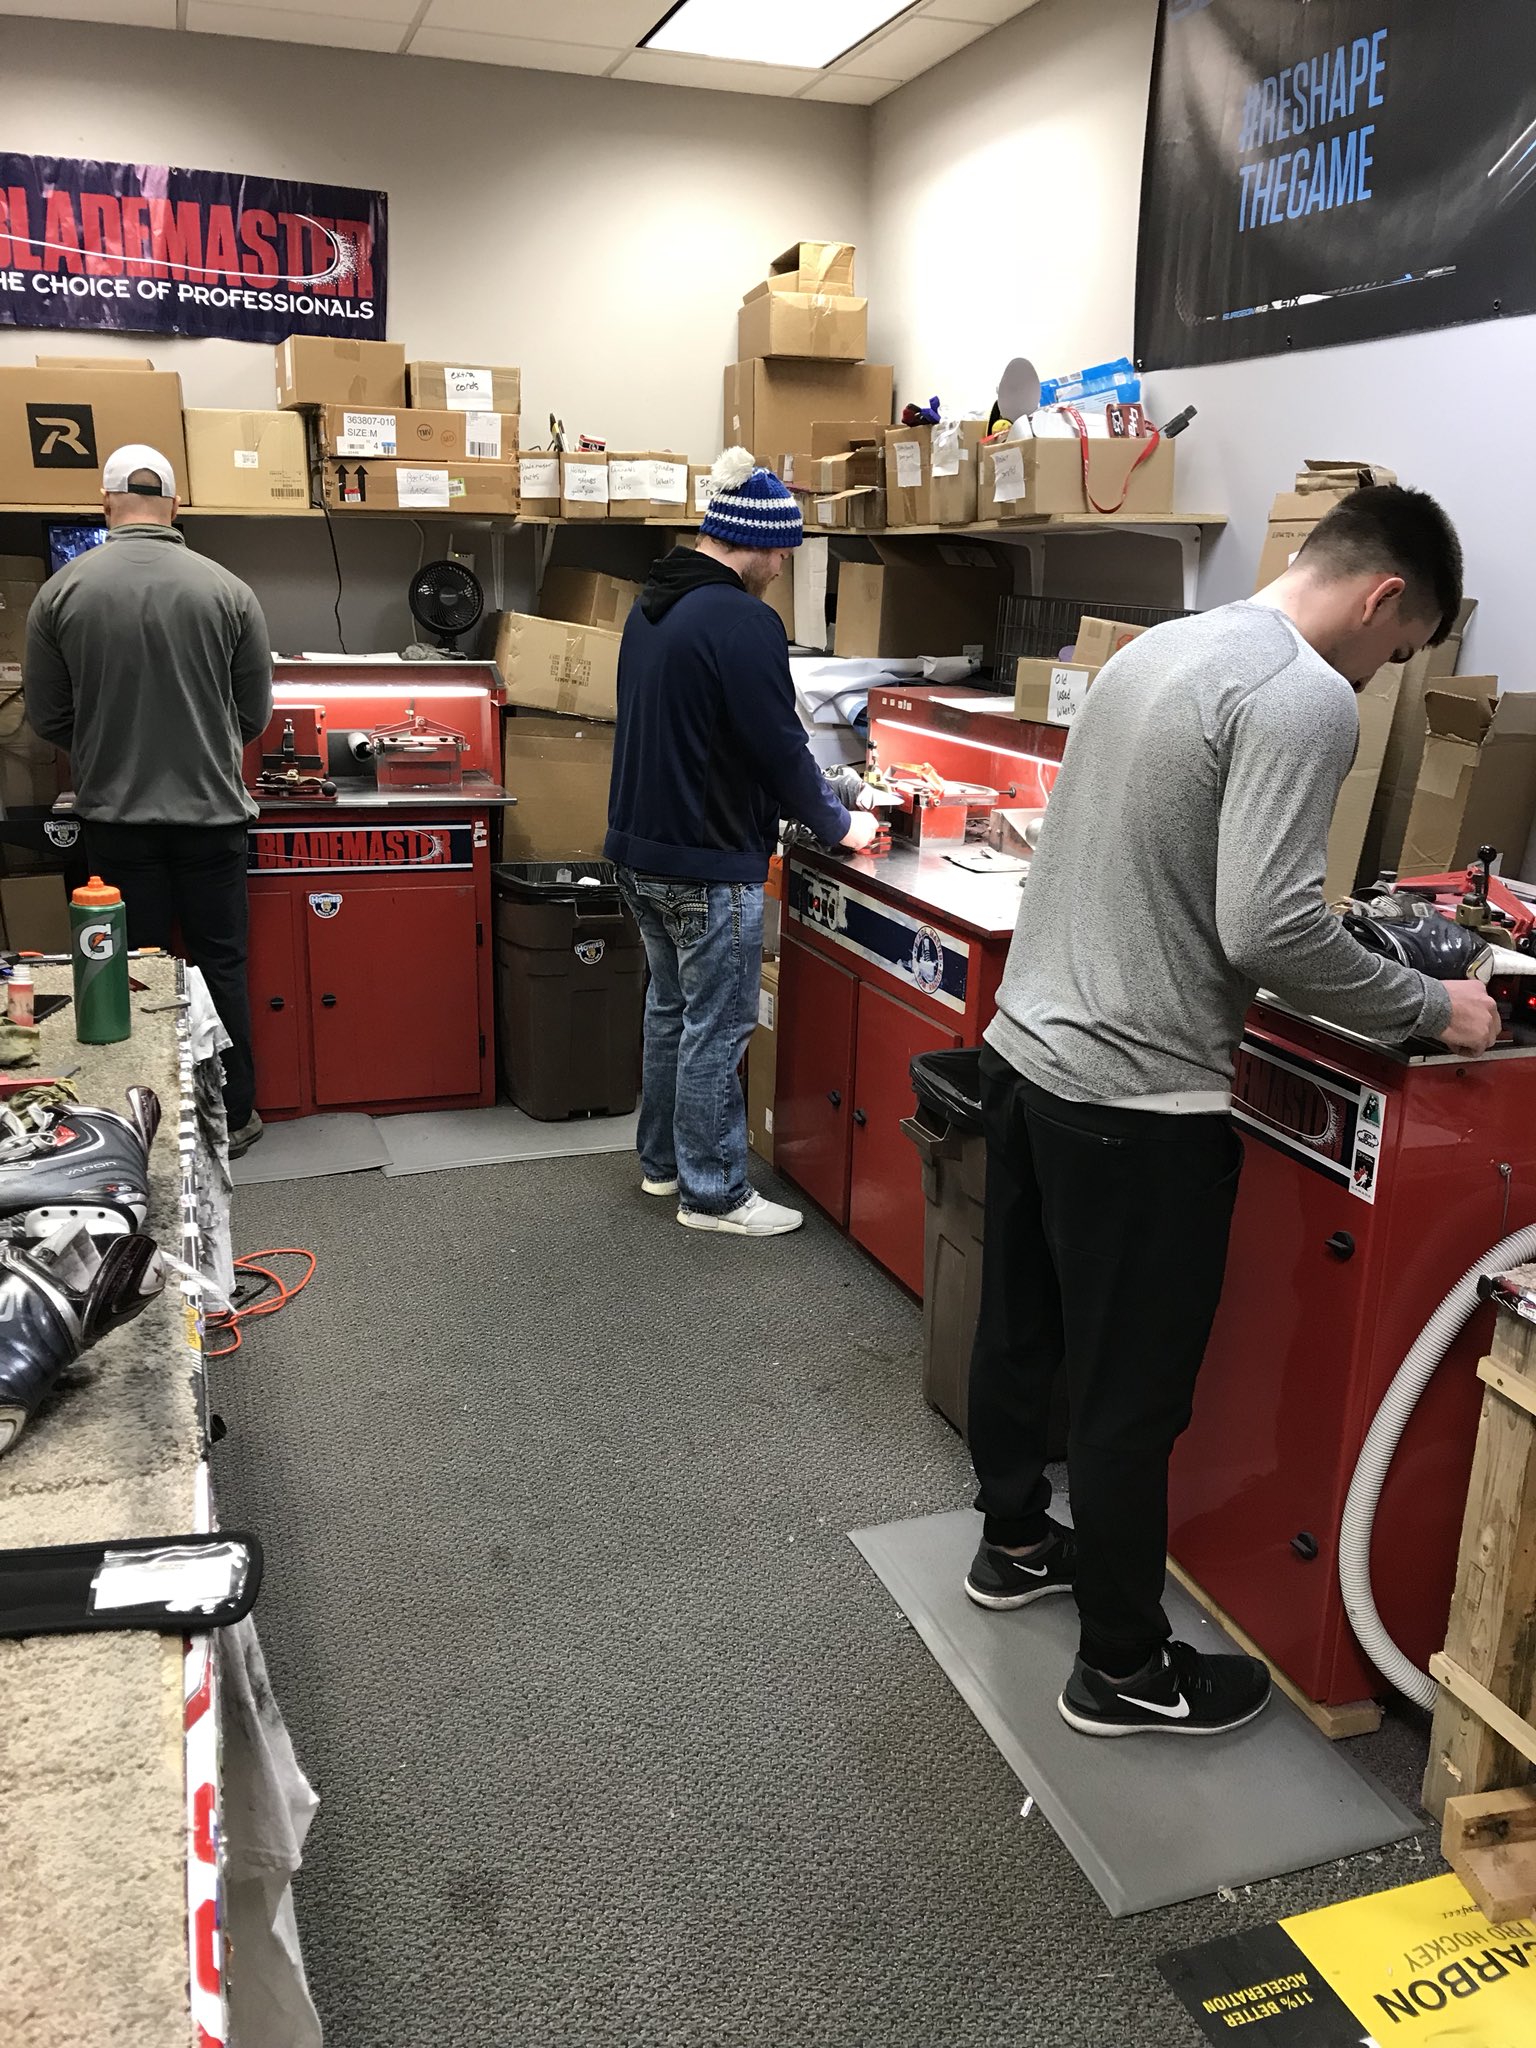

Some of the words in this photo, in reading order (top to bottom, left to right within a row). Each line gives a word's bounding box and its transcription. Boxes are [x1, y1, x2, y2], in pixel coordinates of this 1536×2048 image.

[1239, 28, 1388, 153] #RESHAPE
[1239, 125, 1375, 232] THEGAME
[32, 273, 131, 298] CHOICE
[137, 279, 173, 302] OF
[178, 282, 375, 320] PROFESSIONALS
[346, 415, 396, 427] 363807-010
[1055, 673, 1068, 685] Old
[256, 829, 453, 870] BLADEMASTER
[79, 923, 114, 960] G
[1407, 1929, 1489, 1972] HOCKEY
[1487, 1921, 1533, 1941] PRO
[1201, 1972, 1310, 2015] ACCELERATION
[1281, 1991, 1314, 2011] 11%
[1223, 2002, 1281, 2028] BETTER
